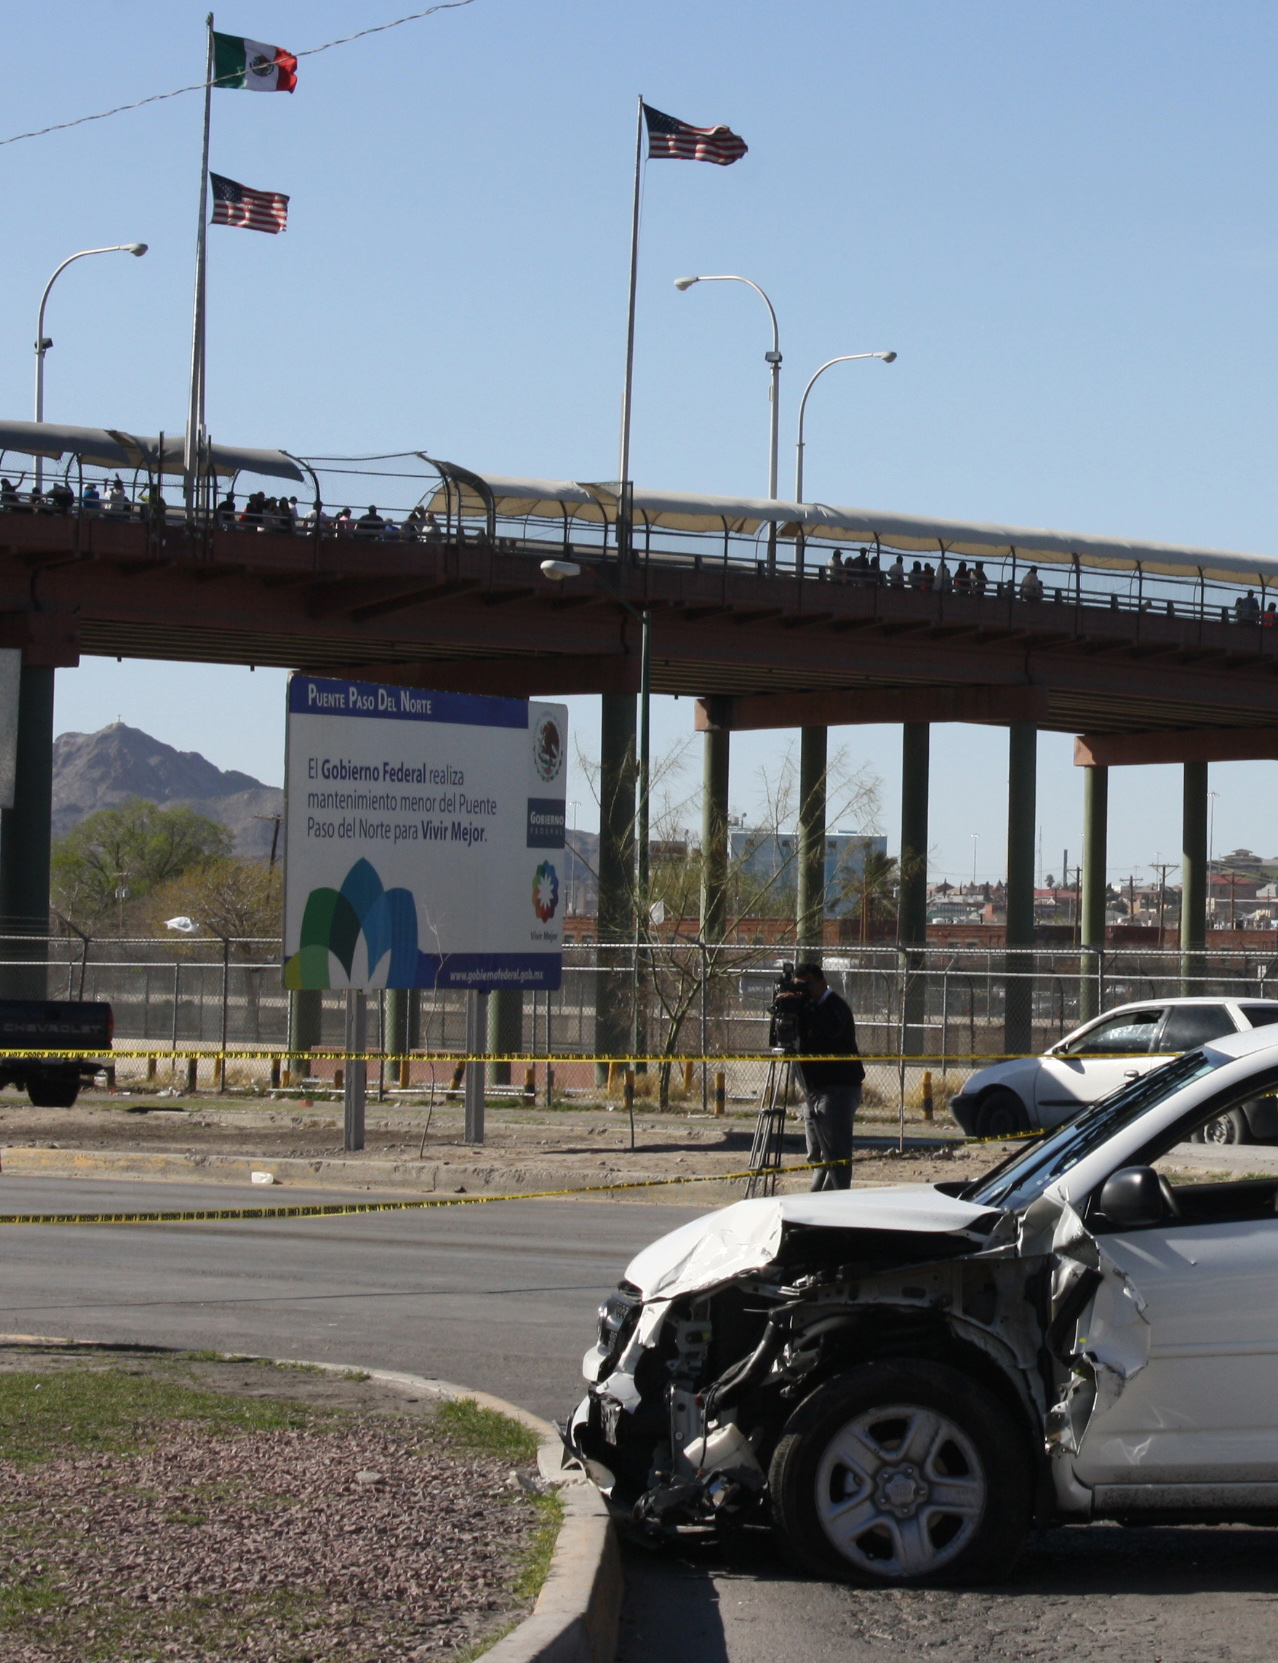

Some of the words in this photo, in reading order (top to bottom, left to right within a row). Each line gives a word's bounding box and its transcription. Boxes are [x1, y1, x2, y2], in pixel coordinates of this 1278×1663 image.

[308, 683, 345, 708] PUENTE
[349, 686, 375, 710] PASO
[400, 690, 432, 714] NORTE
[308, 757, 318, 779] El
[321, 758, 380, 782] Gobierno
[383, 761, 426, 784] Federal
[429, 763, 464, 786] realiza
[307, 789, 398, 811] mantenimiento
[400, 796, 437, 813] menor
[439, 792, 456, 814] del
[459, 793, 497, 816] Puente
[307, 816, 335, 839] Paso
[338, 816, 356, 839] del
[359, 818, 391, 840] Norte
[393, 822, 418, 845] para
[421, 819, 448, 841] Vivir
[450, 820, 488, 848] Mejor.
[3, 1022, 102, 1035] CHEVROLET
